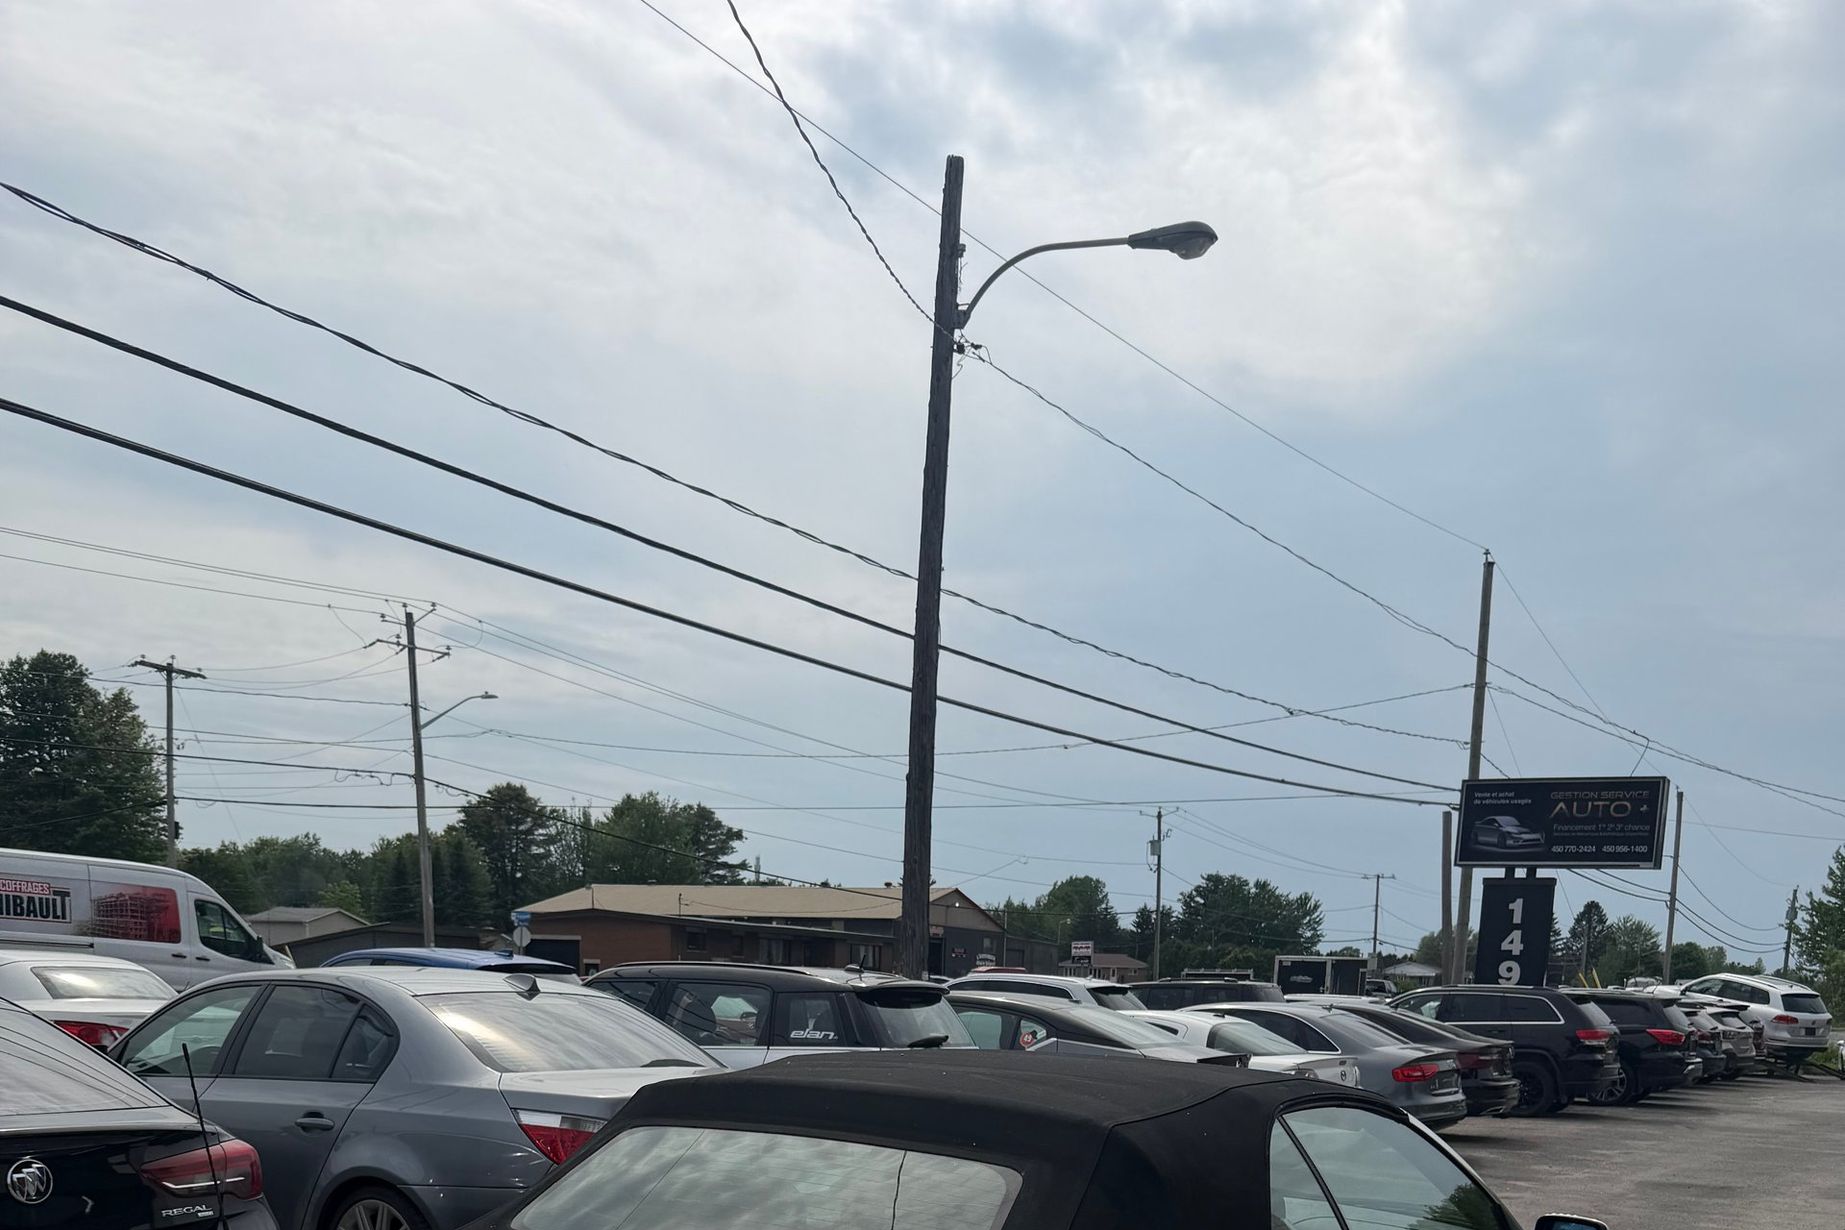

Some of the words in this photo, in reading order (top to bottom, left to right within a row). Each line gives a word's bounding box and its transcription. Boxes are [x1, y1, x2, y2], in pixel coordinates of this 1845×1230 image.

[1550, 791, 1598, 800] GESTION
[1600, 790, 1650, 799] SERVICE
[1549, 801, 1631, 817] AUTO
[1553, 823, 1597, 832] Financement
[1624, 823, 1650, 832] chance
[1551, 845, 1564, 853] 450
[1602, 845, 1615, 853] 450
[0, 879, 50, 895] COFFRAGES
[1498, 898, 1524, 985] 149
[161, 1204, 213, 1218] REGAL
